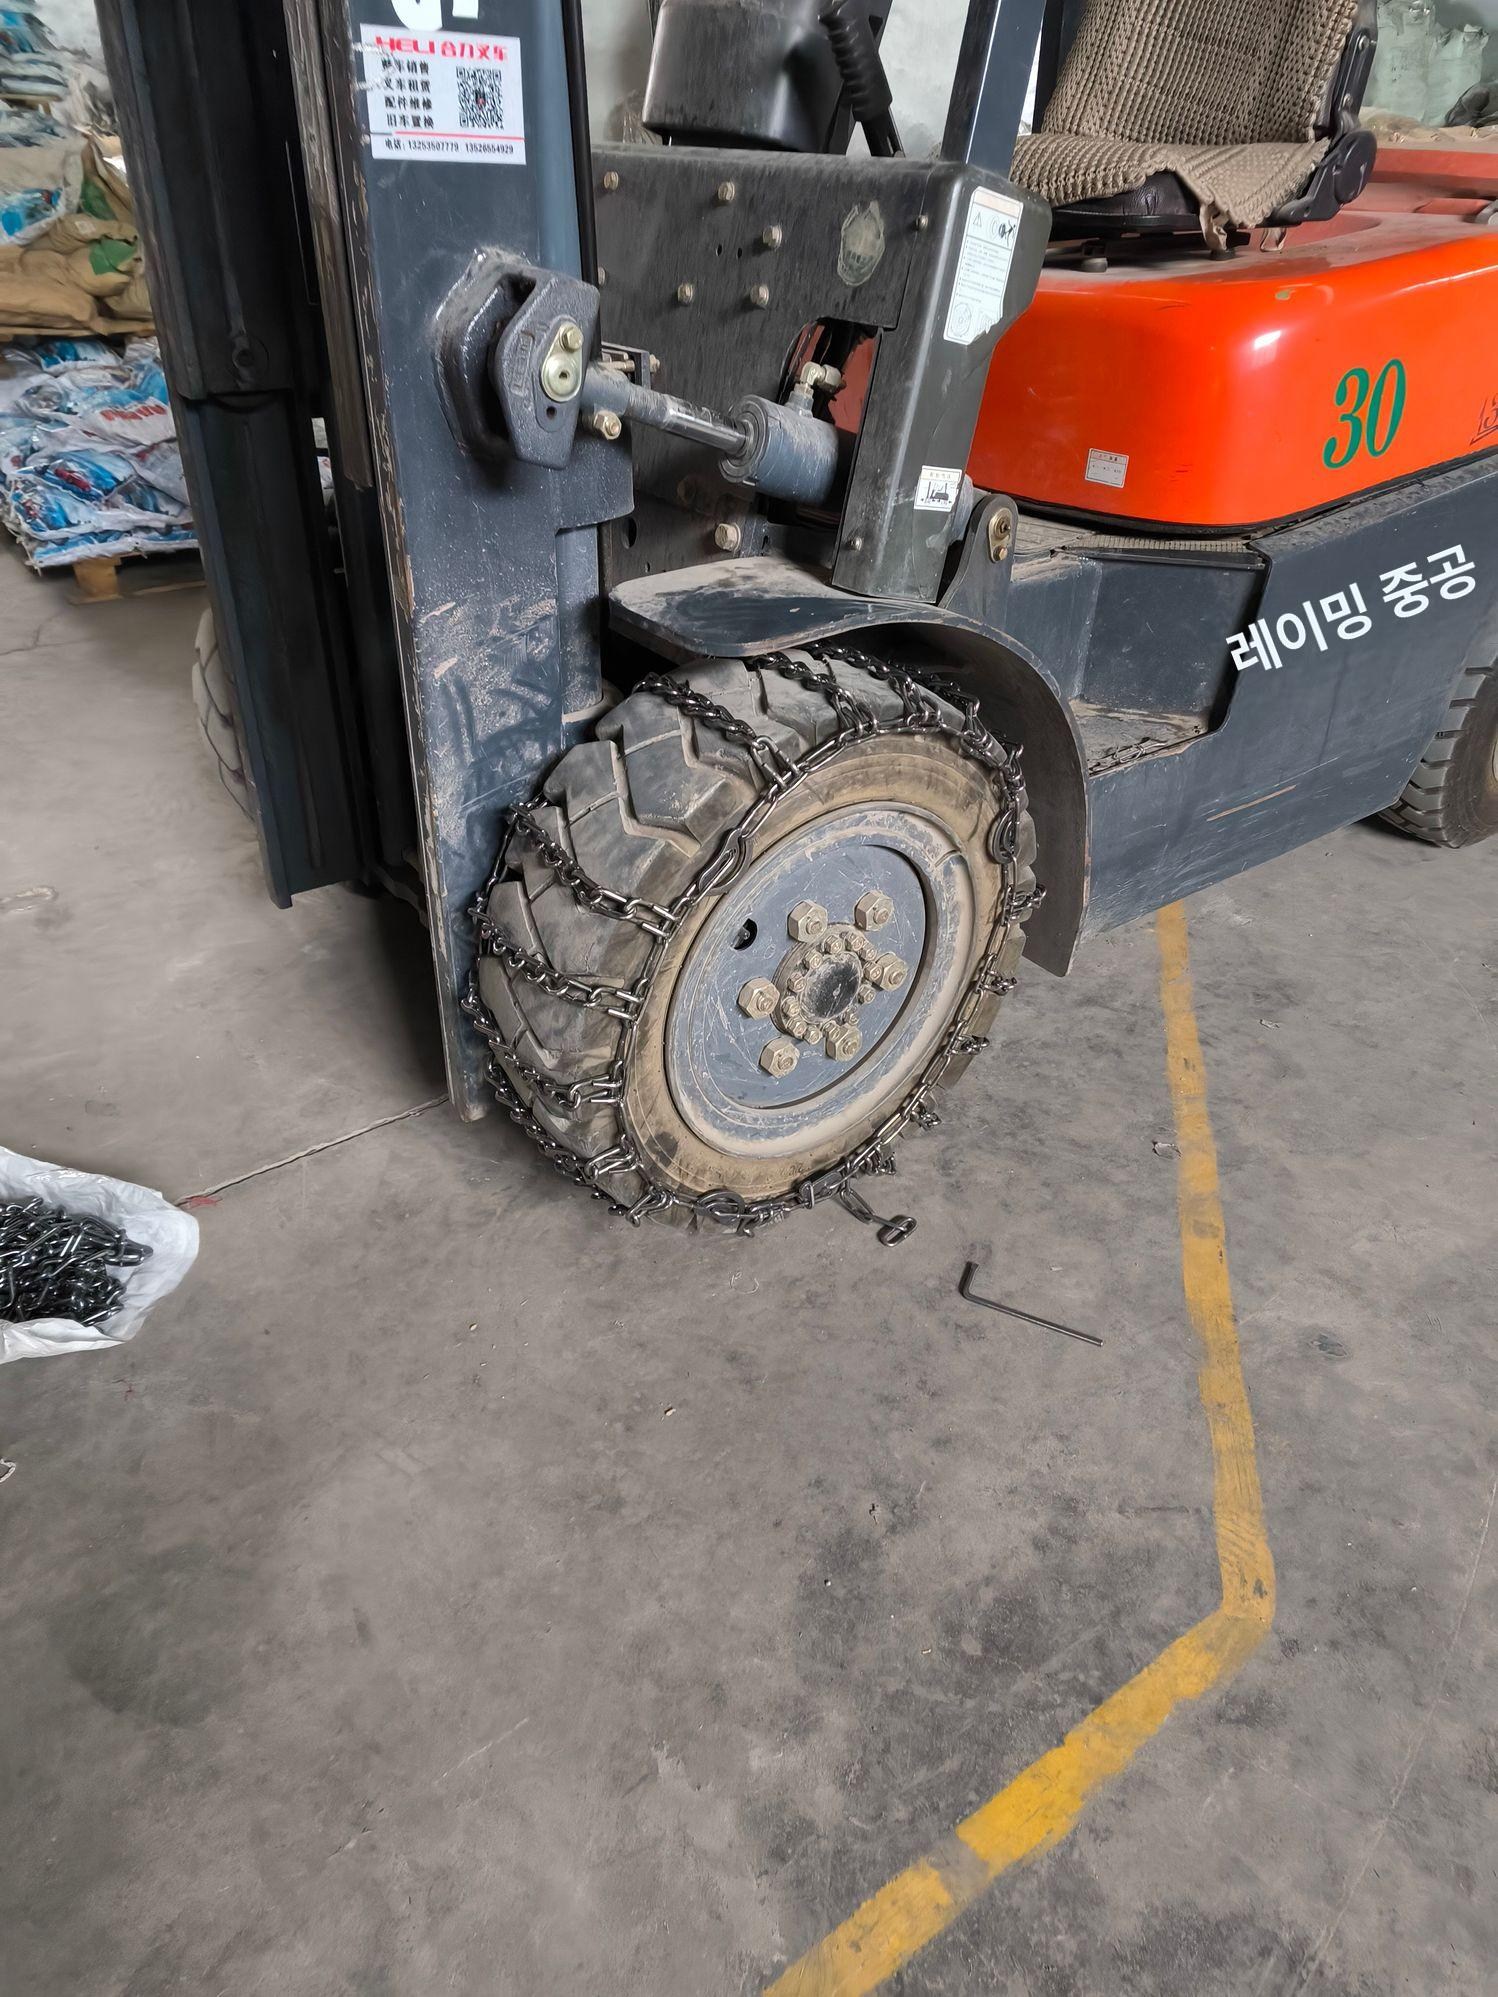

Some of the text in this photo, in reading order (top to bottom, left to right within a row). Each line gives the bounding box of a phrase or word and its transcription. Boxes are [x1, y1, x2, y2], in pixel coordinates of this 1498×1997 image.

[376, 36, 506, 61] HELI 合力叉车
[1322, 358, 1407, 469] 30
